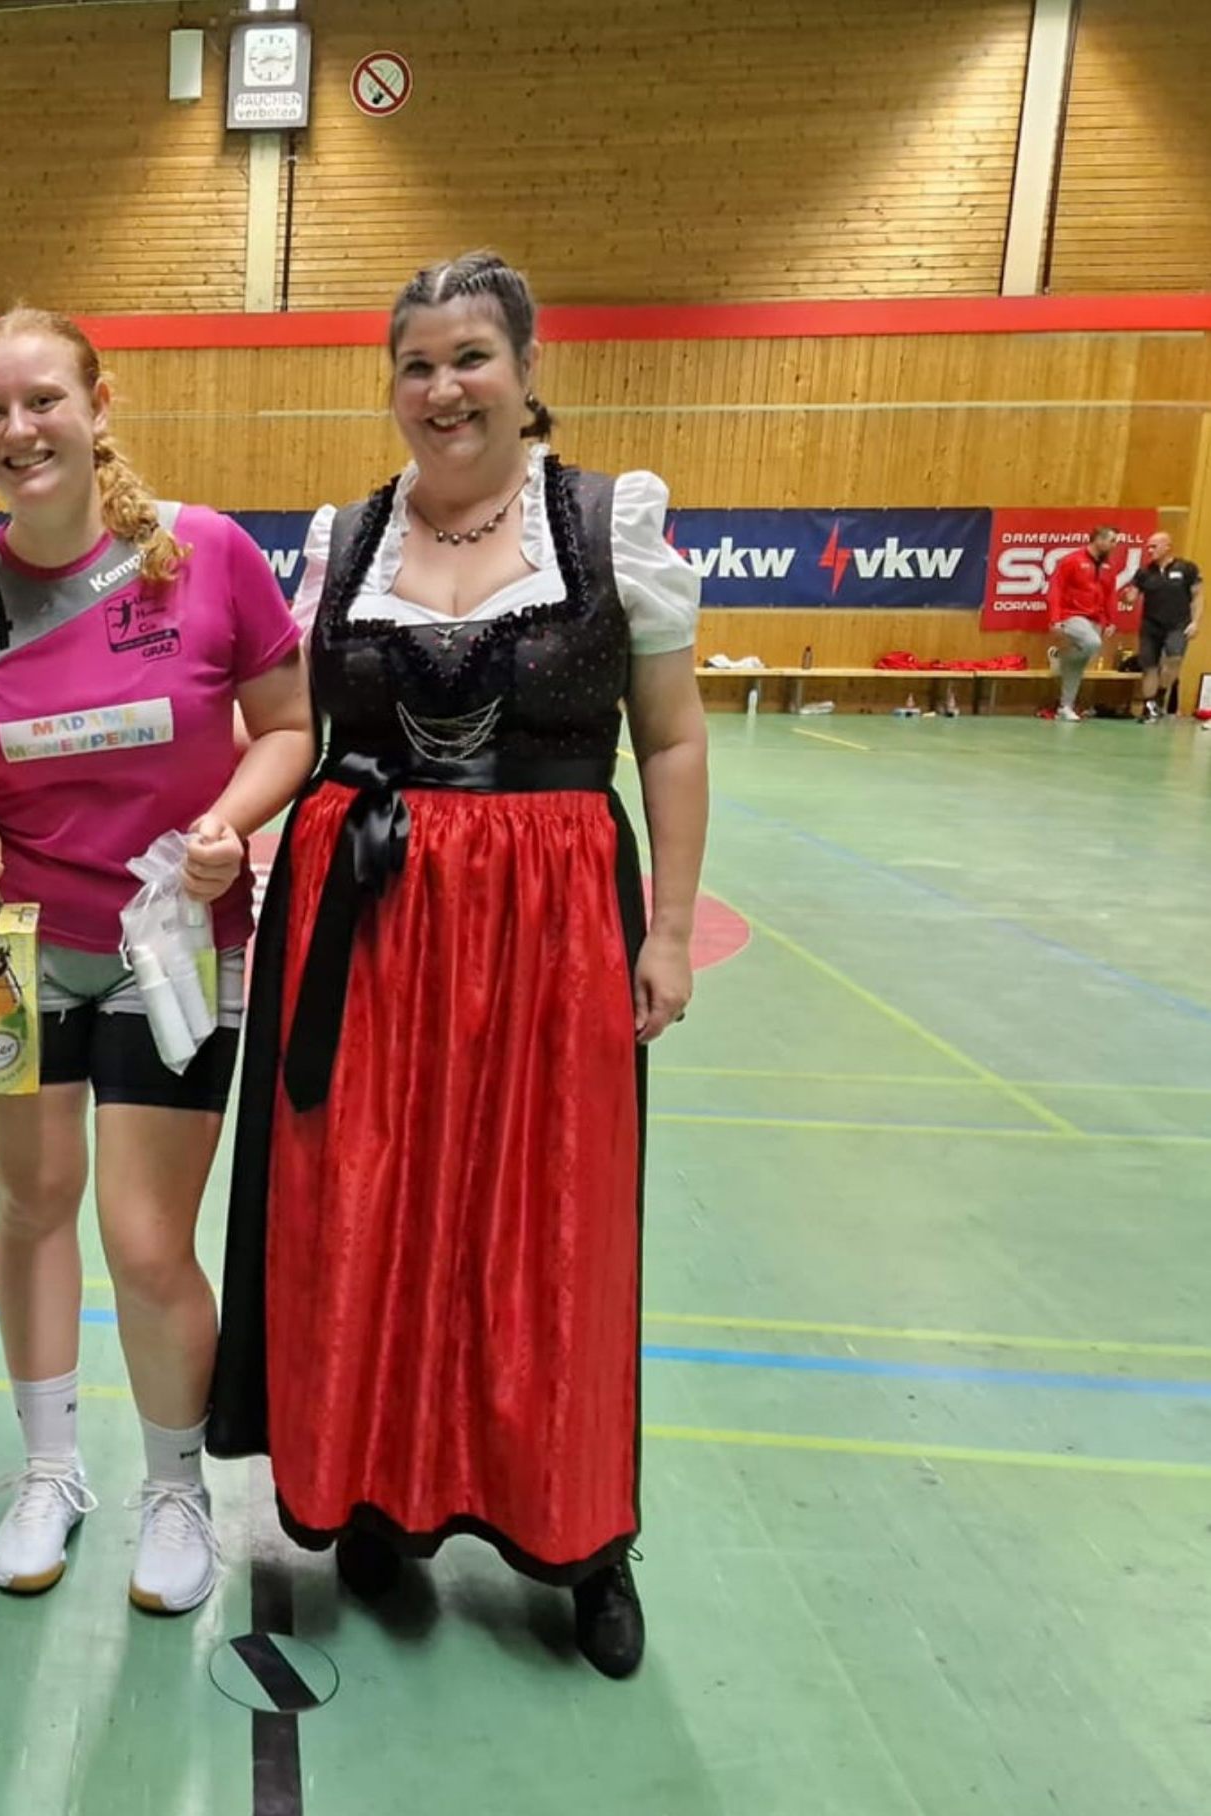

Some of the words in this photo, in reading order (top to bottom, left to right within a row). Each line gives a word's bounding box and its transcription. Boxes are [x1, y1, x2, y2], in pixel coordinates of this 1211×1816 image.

[688, 536, 796, 578] vkw
[853, 536, 964, 578] vkw
[1002, 532, 1144, 544] DAMENHANALL
[89, 550, 145, 592] Kemp
[5, 722, 171, 759] MONEYPENNY
[32, 707, 137, 737] MADAME
